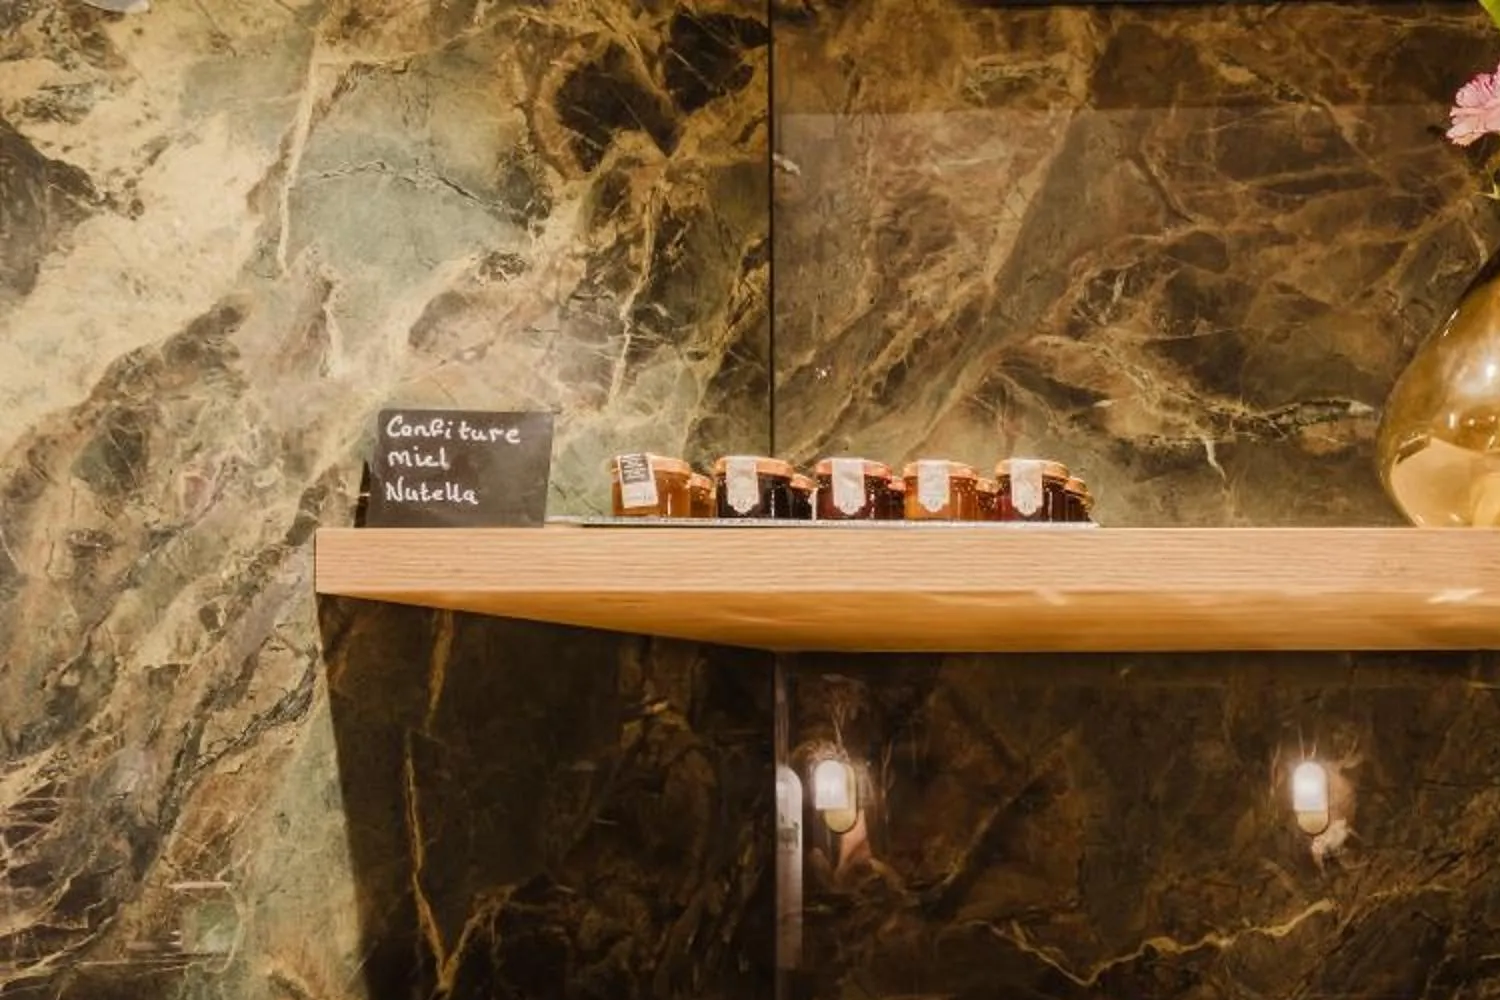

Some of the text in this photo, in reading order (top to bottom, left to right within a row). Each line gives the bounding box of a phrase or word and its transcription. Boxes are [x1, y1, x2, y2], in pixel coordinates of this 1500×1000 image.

[386, 414, 521, 444] Confiture
[387, 446, 450, 471] Miel
[384, 475, 480, 505] Nutella
